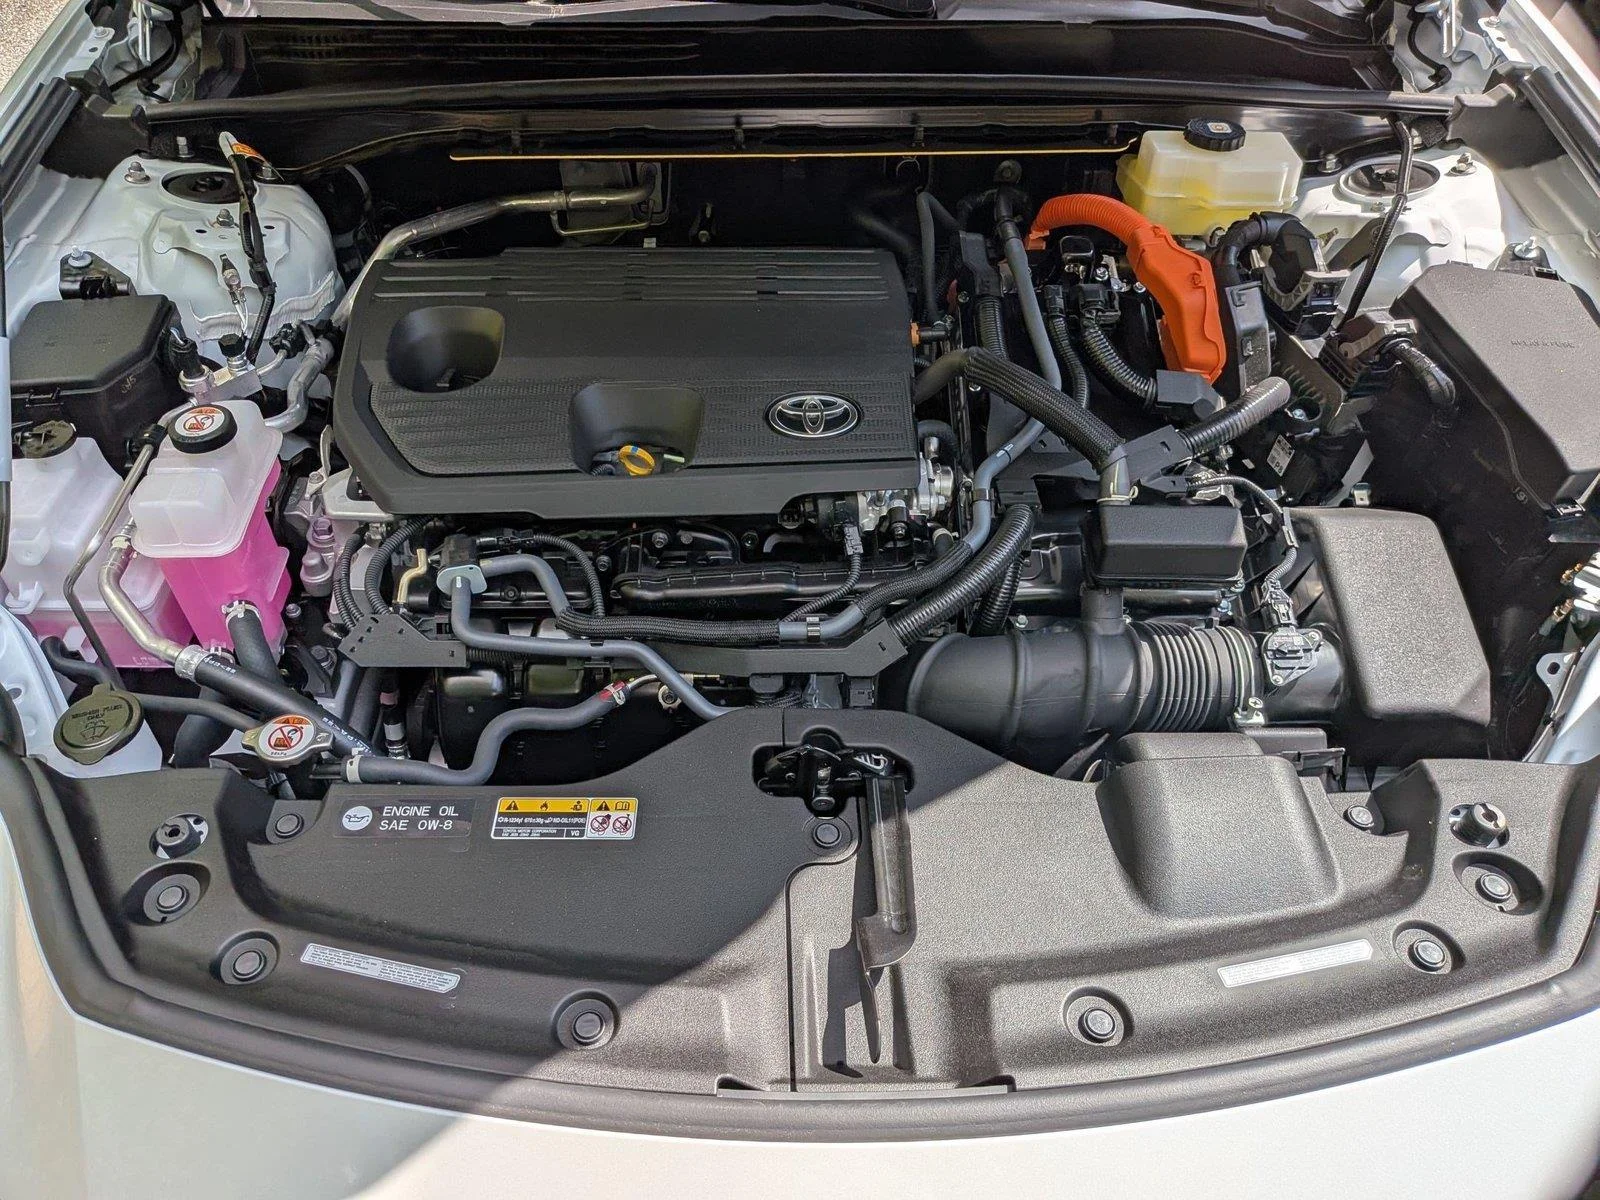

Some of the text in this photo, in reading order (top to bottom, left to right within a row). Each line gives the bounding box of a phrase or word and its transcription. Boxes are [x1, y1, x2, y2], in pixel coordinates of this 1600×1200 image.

[382, 806, 459, 816] ENGINE OIL
[379, 820, 453, 830] SAE 0W-8
